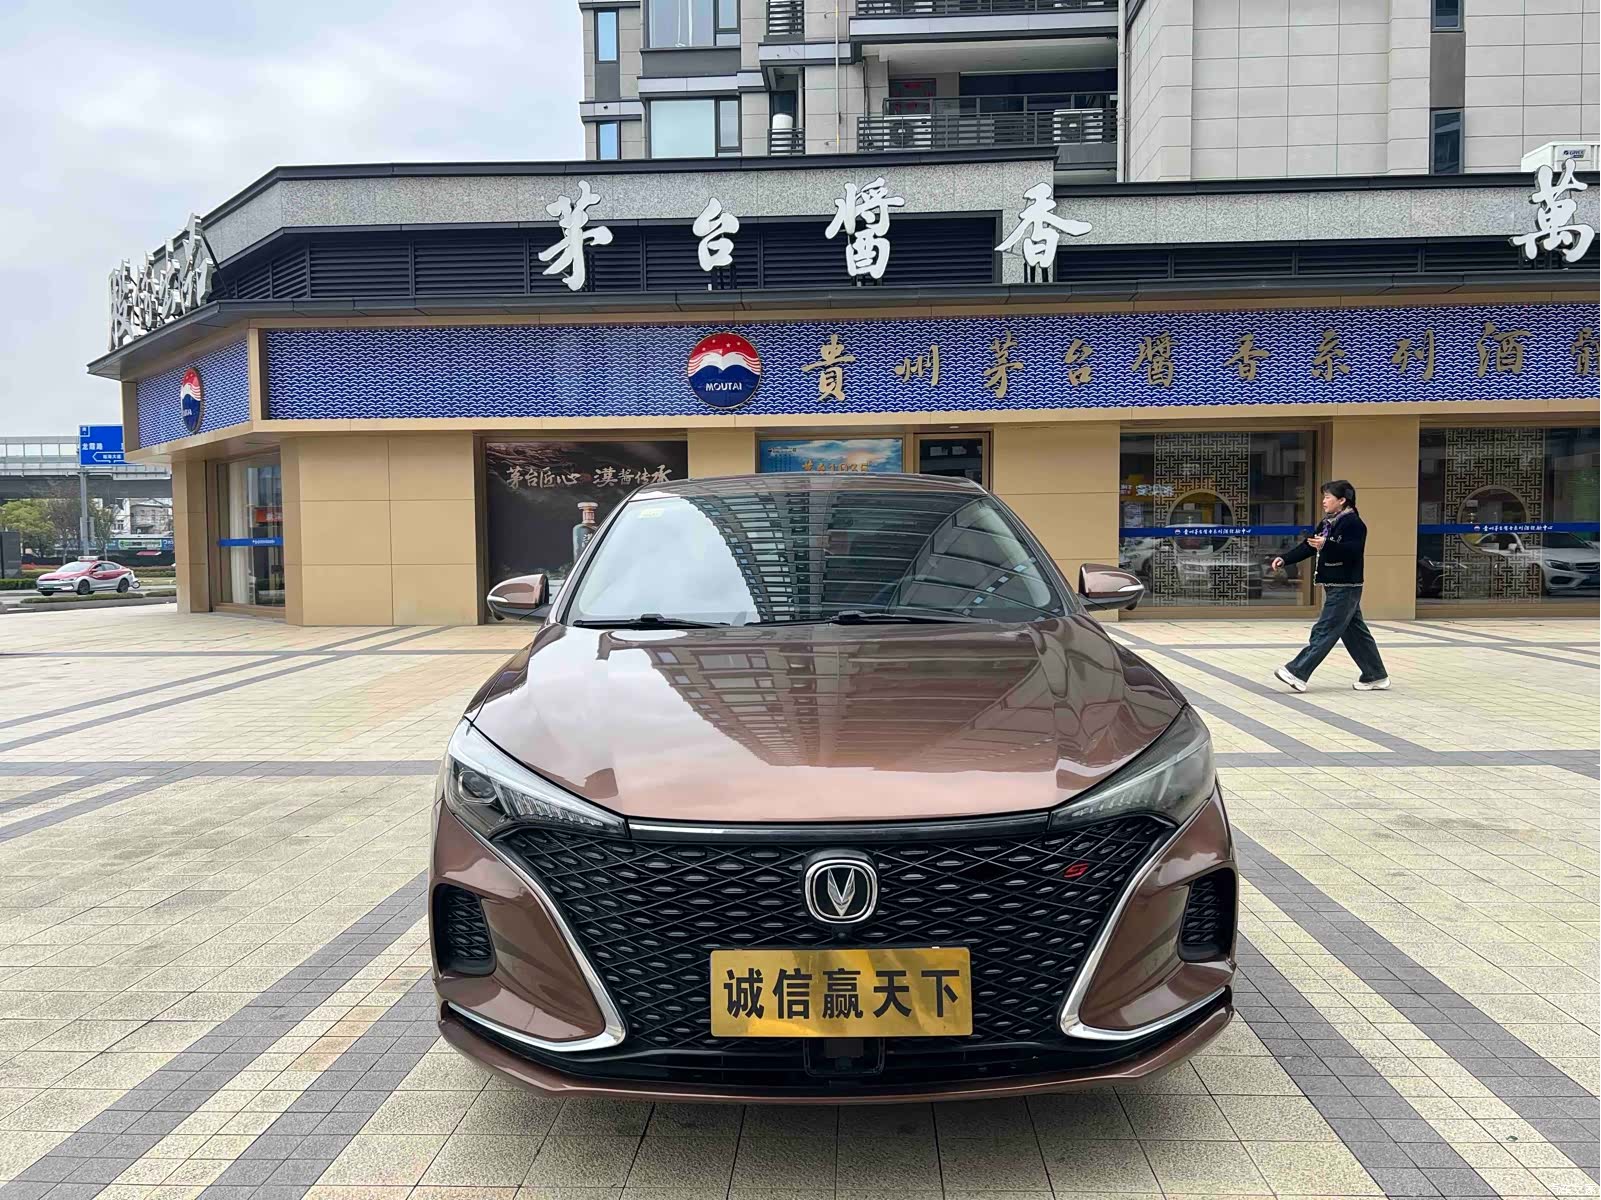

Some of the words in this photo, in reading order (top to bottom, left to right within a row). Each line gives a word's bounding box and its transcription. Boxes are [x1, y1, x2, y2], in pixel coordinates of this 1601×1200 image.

[705, 382, 743, 392] MOUTAI
[506, 465, 581, 489] 茅台匠心
[723, 967, 960, 1020] 诚信赢天下
